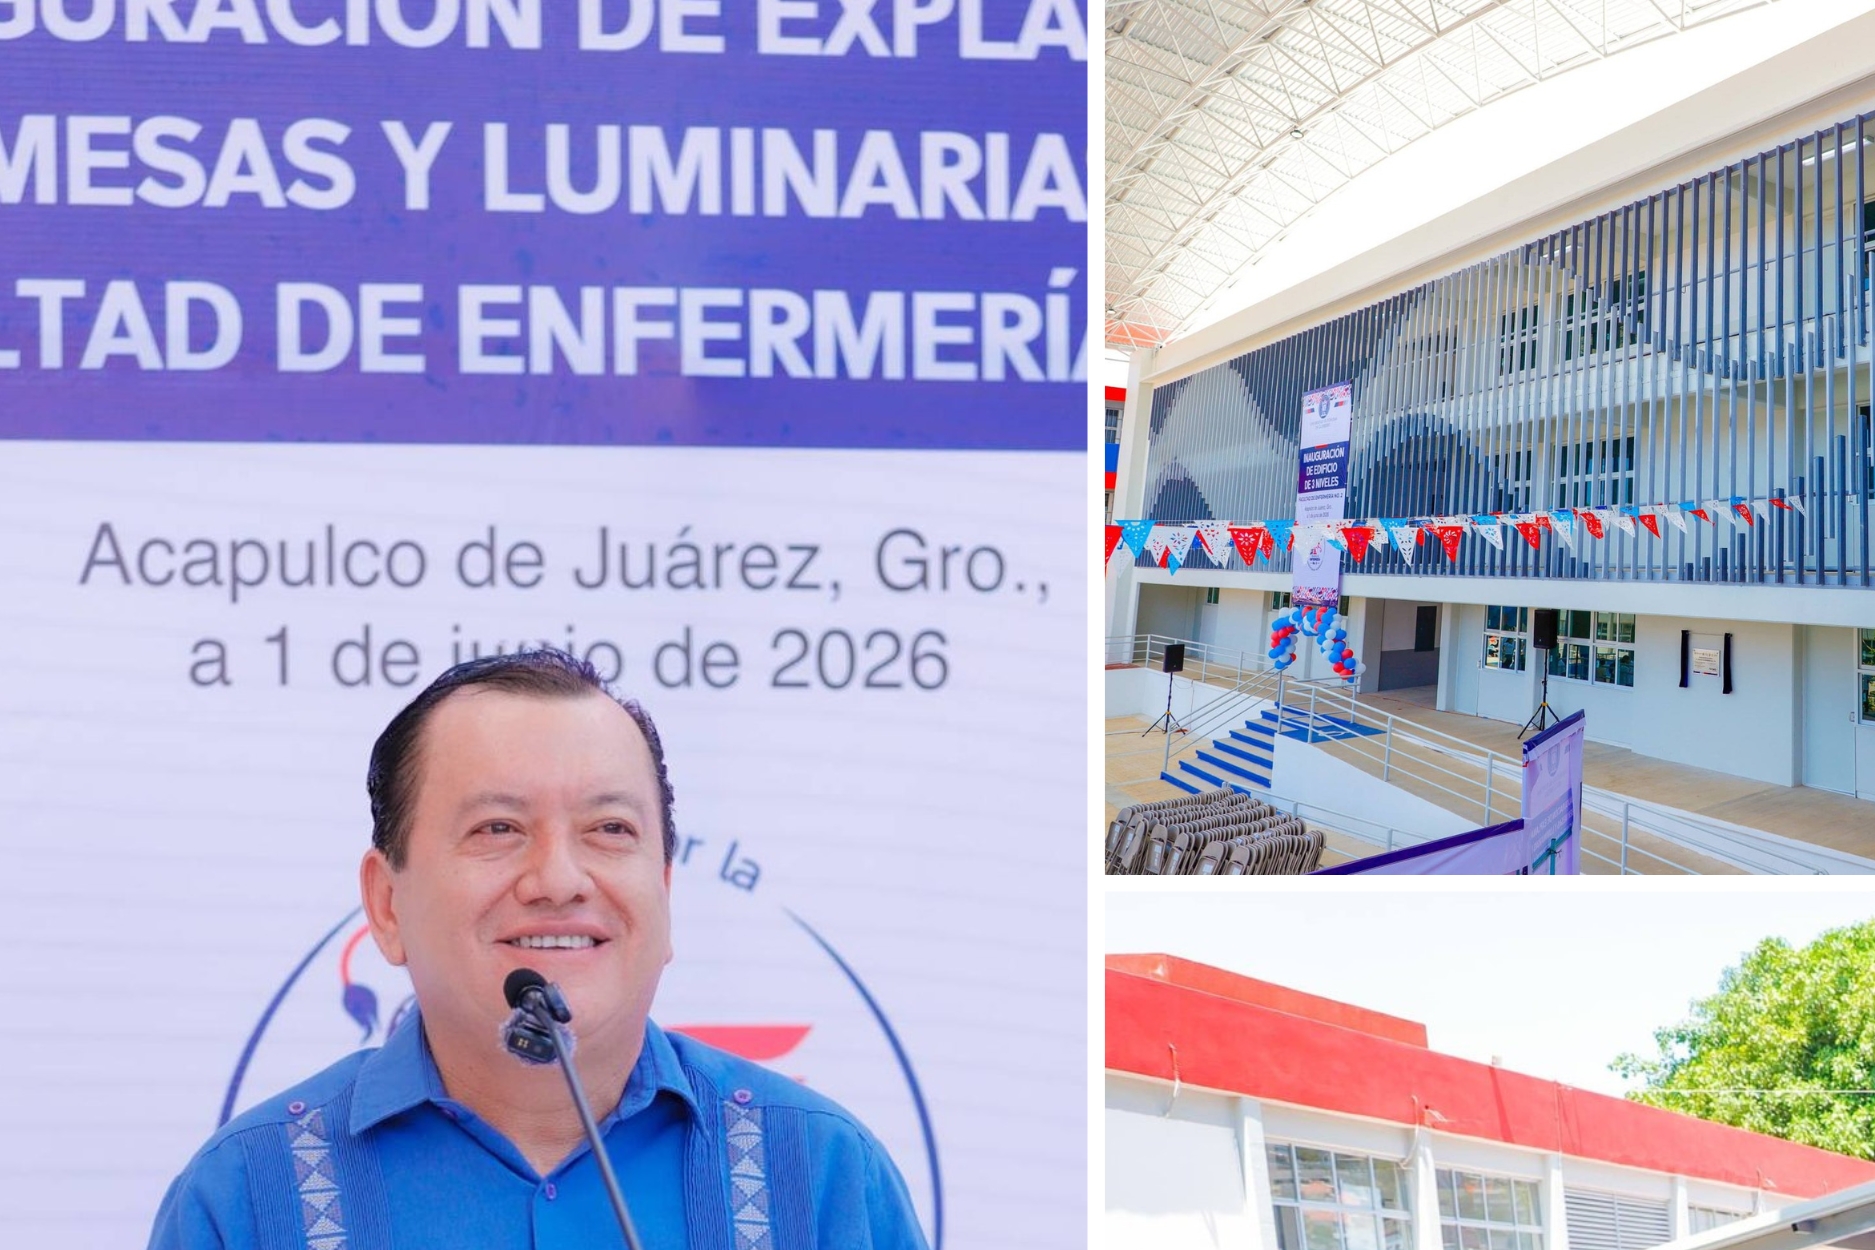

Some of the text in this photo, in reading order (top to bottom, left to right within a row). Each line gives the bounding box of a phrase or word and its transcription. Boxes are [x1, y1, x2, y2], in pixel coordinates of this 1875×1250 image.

[0, 114, 1087, 222] MESAS Y LUMINARIA
[276, 281, 426, 373] DE
[459, 266, 1087, 383] ENFERMERÍ
[1304, 479, 1312, 490] DE
[1306, 465, 1314, 476] DE
[79, 522, 1050, 604] Acapulco de Juárez, Gro.,
[188, 640, 232, 688] a
[266, 629, 292, 684] 1
[331, 625, 420, 688] de
[652, 626, 741, 689] de
[769, 630, 950, 690] 2026
[719, 839, 761, 892] la
